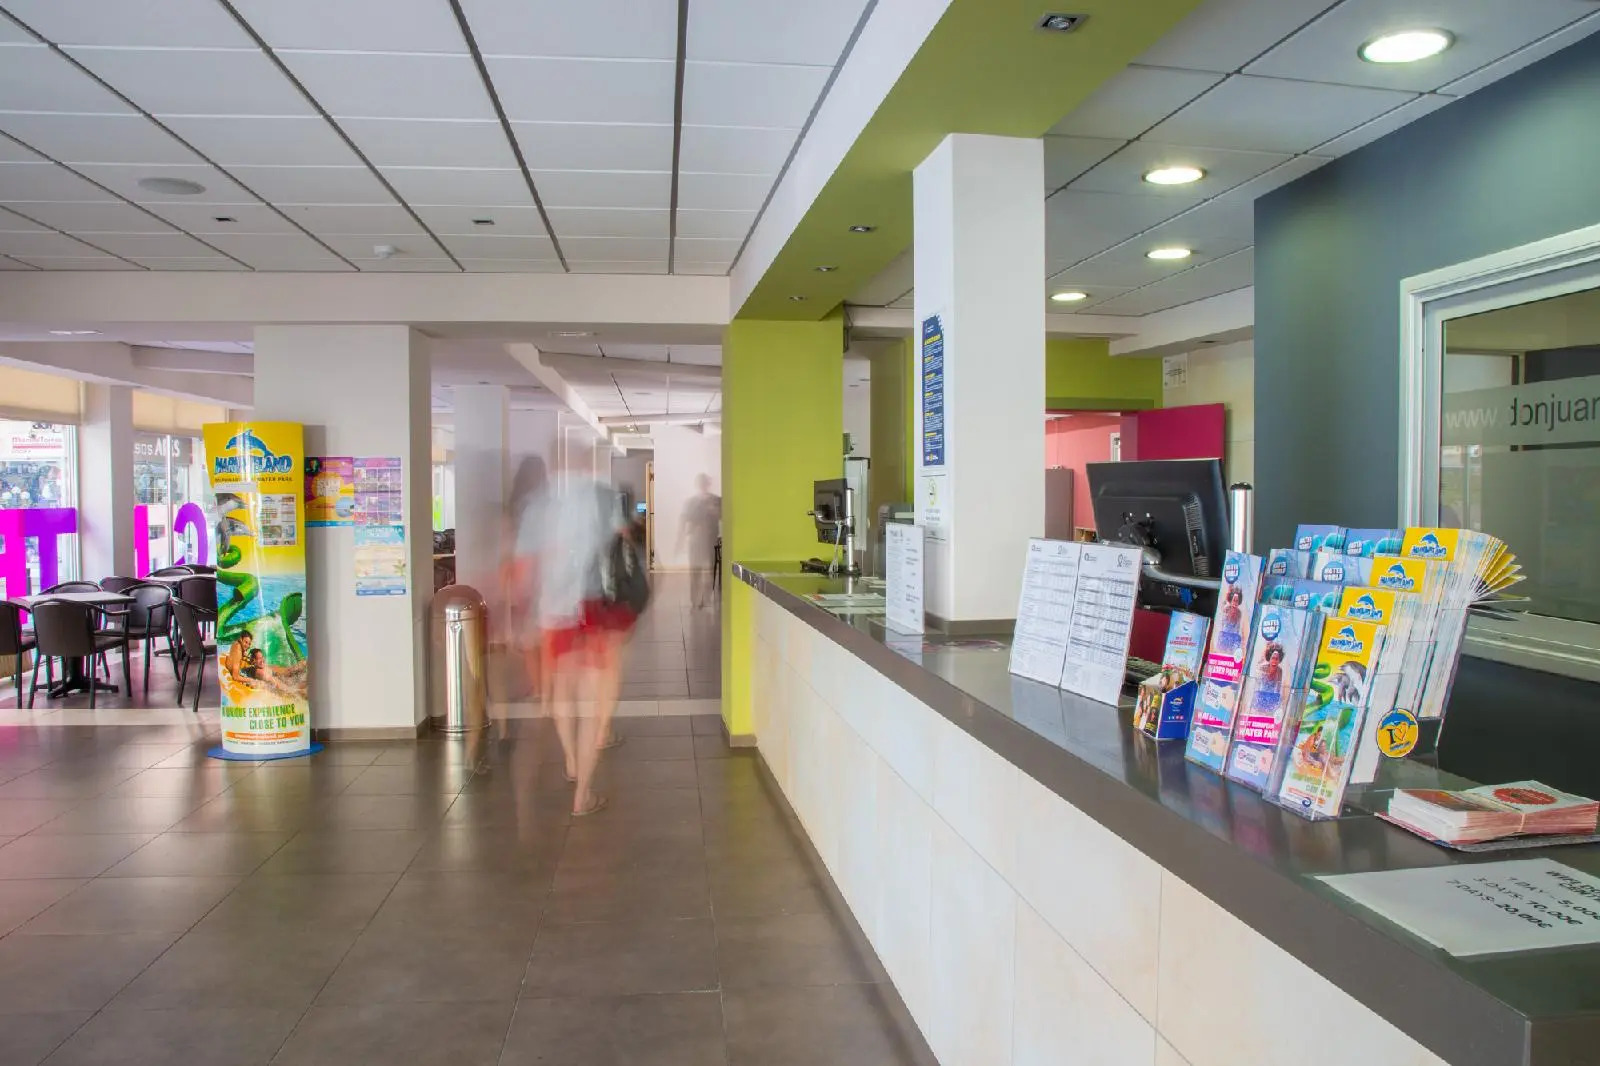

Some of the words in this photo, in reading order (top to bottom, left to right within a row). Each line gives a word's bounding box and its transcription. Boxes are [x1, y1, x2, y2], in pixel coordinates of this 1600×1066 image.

[214, 455, 293, 475] MARELAND
[1226, 668, 1240, 678] PARK
[248, 704, 295, 718] EXPERIENCE
[249, 719, 274, 730] CLOSE
[277, 717, 287, 729] TO
[289, 713, 305, 726] YOU
[1240, 728, 1263, 738] WATER
[1263, 730, 1279, 739] PARK
